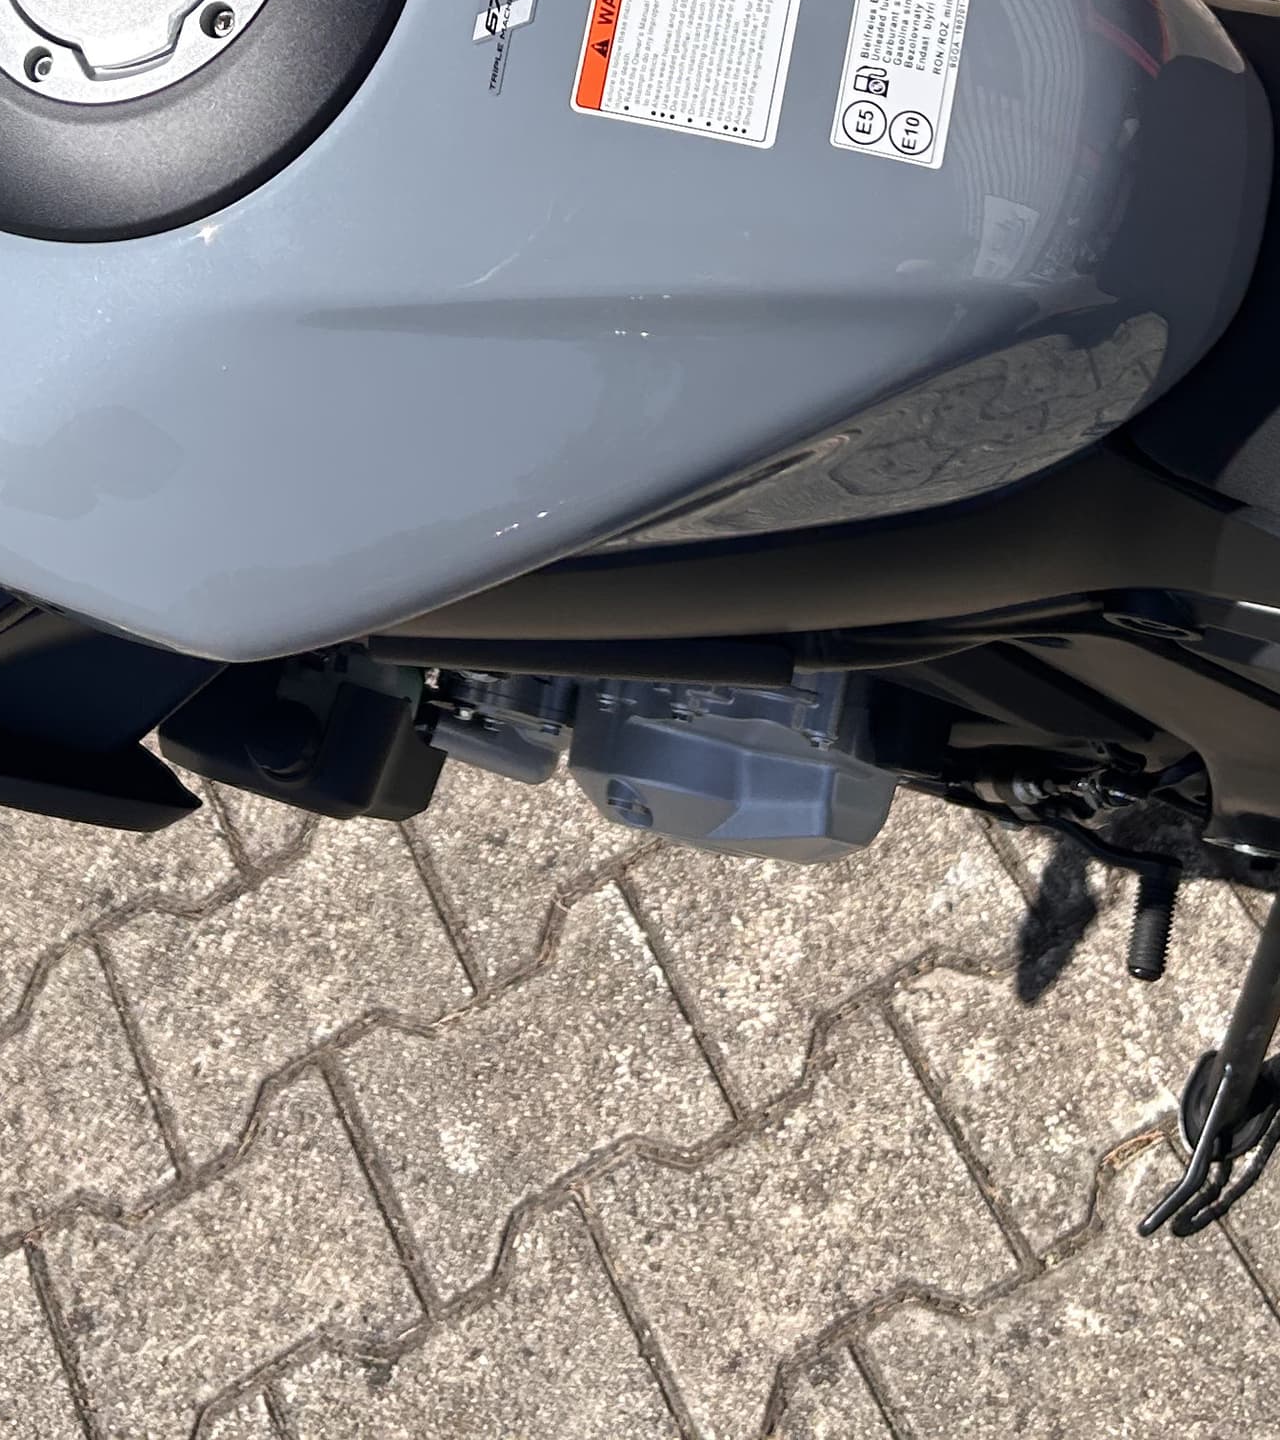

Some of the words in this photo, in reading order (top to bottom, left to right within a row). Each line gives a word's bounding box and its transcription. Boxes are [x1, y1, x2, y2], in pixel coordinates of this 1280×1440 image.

[860, 8, 877, 59] Bleifreies
[872, 15, 886, 61] Unleaded
[883, 11, 899, 64] Carburant
[894, 19, 909, 66] Gasolina
[917, 35, 930, 71] Endast
[924, 2, 937, 29] blyfri
[932, 21, 948, 75] RON/ROZ
[488, 43, 505, 90] TRIPLE
[855, 109, 874, 135] E5
[901, 116, 920, 150] E10
